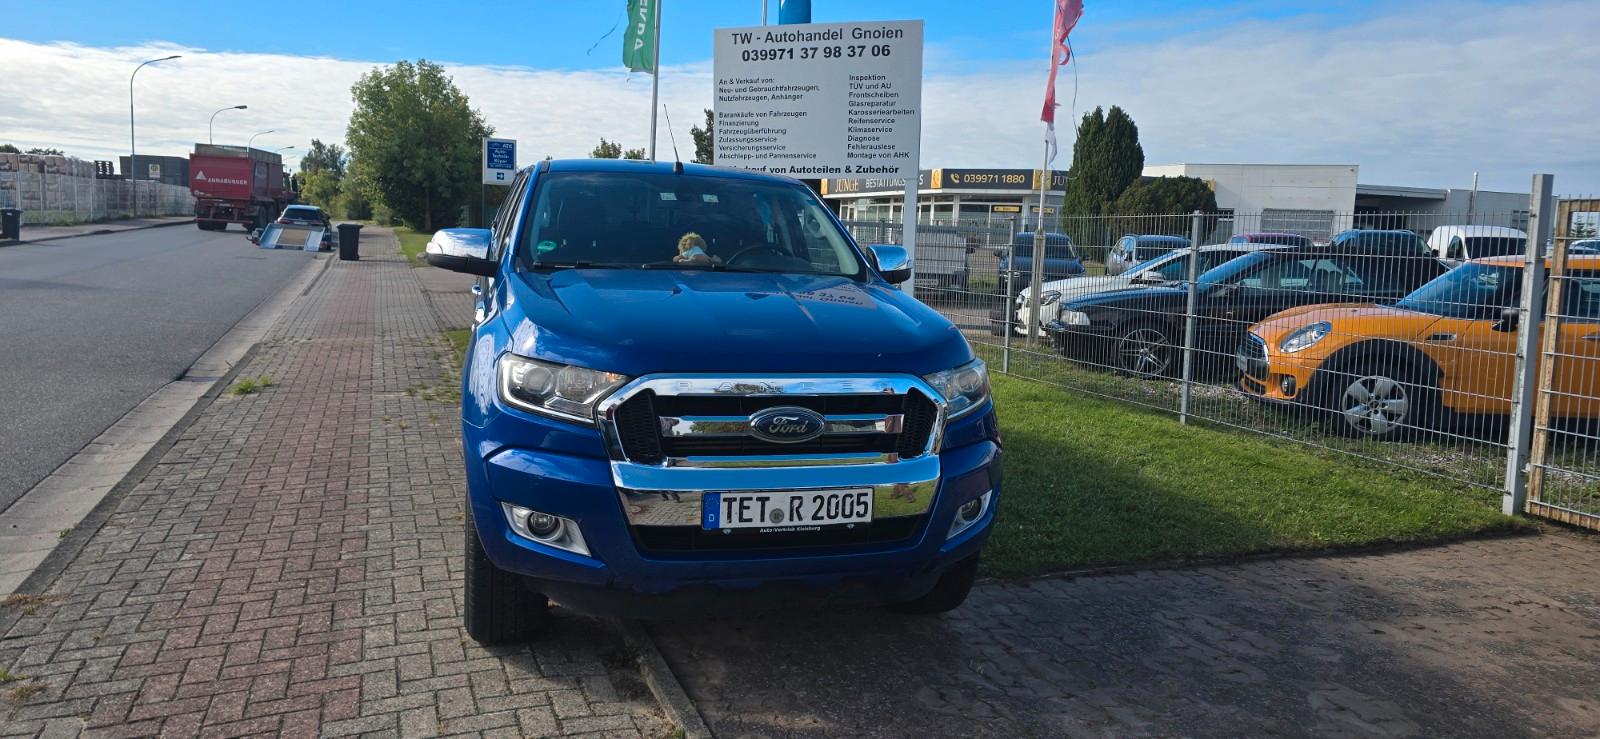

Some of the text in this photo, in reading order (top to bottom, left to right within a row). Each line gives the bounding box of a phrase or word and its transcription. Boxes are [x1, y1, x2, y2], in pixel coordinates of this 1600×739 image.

[732, 33, 753, 45] TW
[764, 28, 843, 43] Autohandel
[851, 26, 904, 40] Gnoien
[741, 44, 891, 62] 039971 37 98 37 06
[849, 74, 886, 82] Inspektion
[881, 82, 892, 90] AU
[719, 93, 804, 102] Nutzfahrzeugen, Anhänger
[848, 91, 899, 99] Frontscheiben
[848, 100, 897, 109] Glasreparatur
[719, 111, 755, 119] Barankäufe
[769, 109, 807, 118] Fahrzeugen
[848, 108, 915, 117] Karosseriearbeiten
[719, 119, 760, 127] Finanzierung
[848, 117, 895, 125] Reifenservice
[719, 127, 787, 136] Fahrzeugüberführung
[847, 126, 893, 134] Klimaservice
[718, 136, 778, 144] Zulassungsservice
[847, 135, 880, 143] Diagnose
[718, 144, 786, 152] Versicherungsservice
[847, 143, 896, 151] Fehlerauslese
[718, 152, 755, 161] Abschlepp-
[768, 151, 817, 159] Pannenservice
[847, 151, 877, 160] Montage
[893, 151, 910, 159] AHK
[789, 165, 841, 174] Autoteilen
[844, 165, 852, 174] &
[855, 164, 899, 174] Zubehör
[207, 177, 248, 185] ANNABURGER
[963, 174, 1025, 184] 039971 1880
[834, 178, 860, 193] JUNGE
[769, 415, 809, 433] Ford
[722, 496, 770, 523] TET
[789, 495, 804, 522] R
[811, 492, 869, 521] 2005
